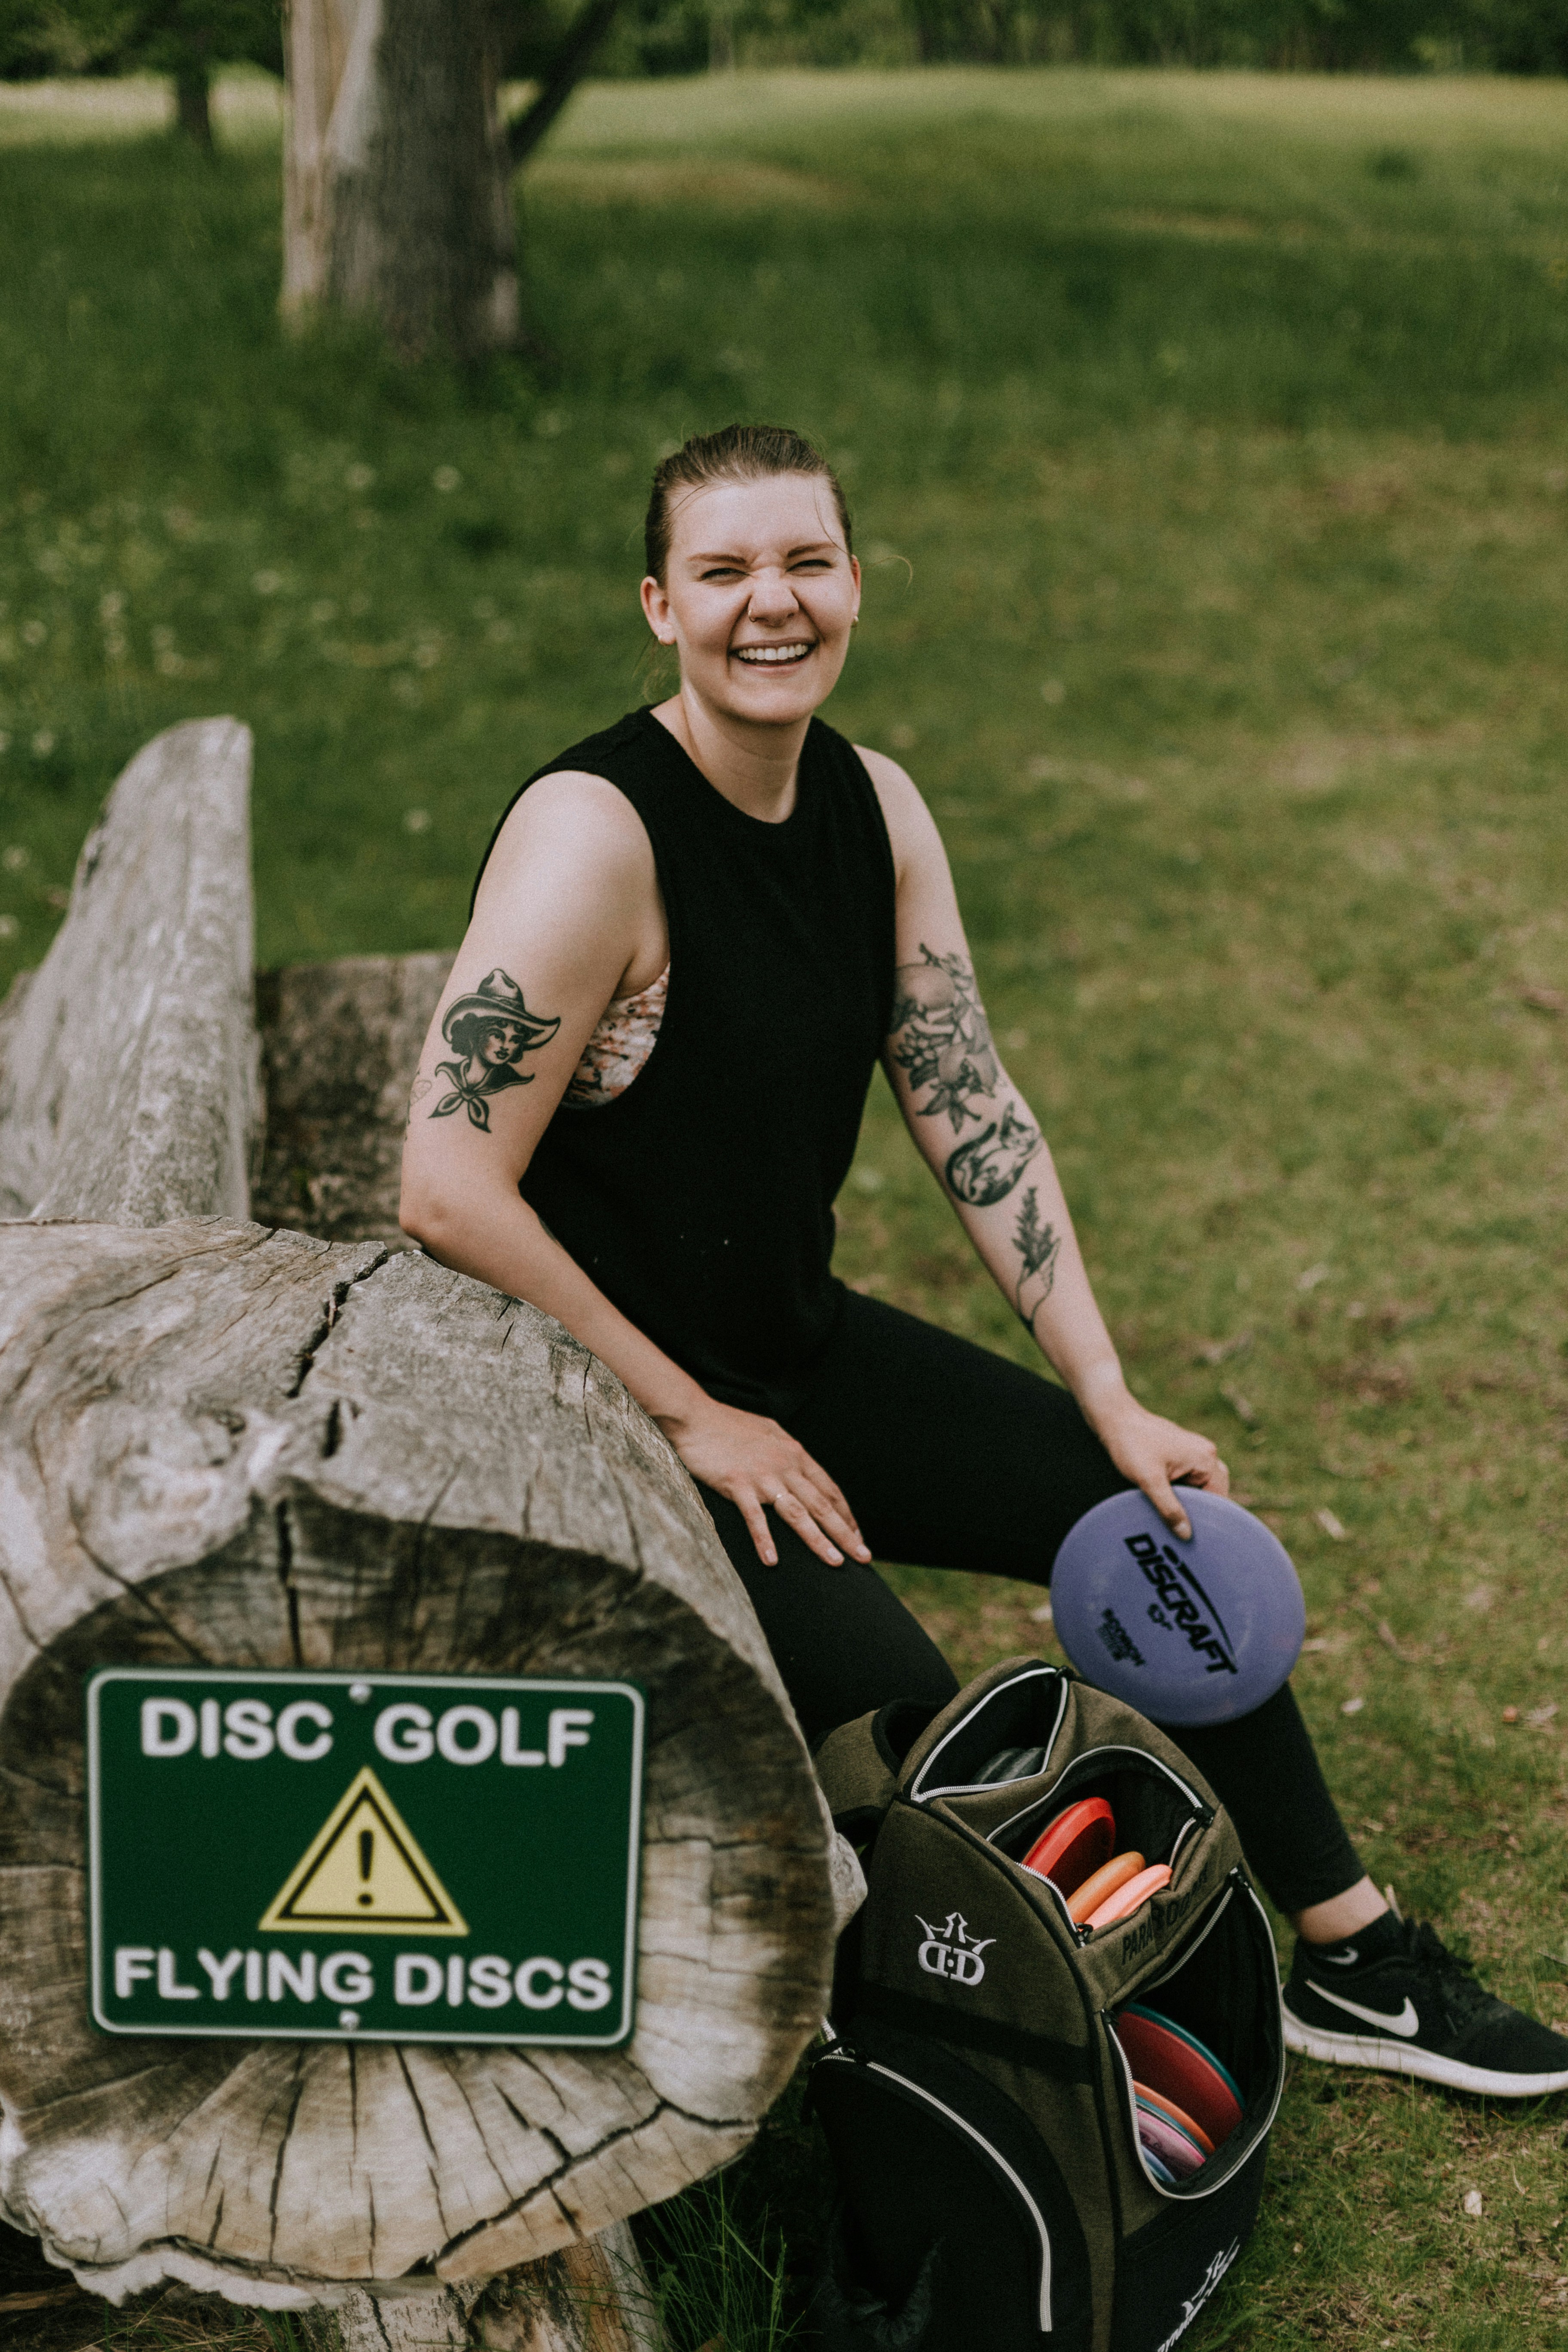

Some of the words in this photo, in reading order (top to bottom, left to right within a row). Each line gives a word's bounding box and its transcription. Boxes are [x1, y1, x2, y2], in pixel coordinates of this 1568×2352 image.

[1124, 1533, 1238, 1675] DISCRAFT
[140, 1697, 334, 1761] DISC
[373, 1702, 595, 1768] GOLF
[113, 1946, 375, 2005] FLYING
[393, 1953, 613, 2011] DISCS
